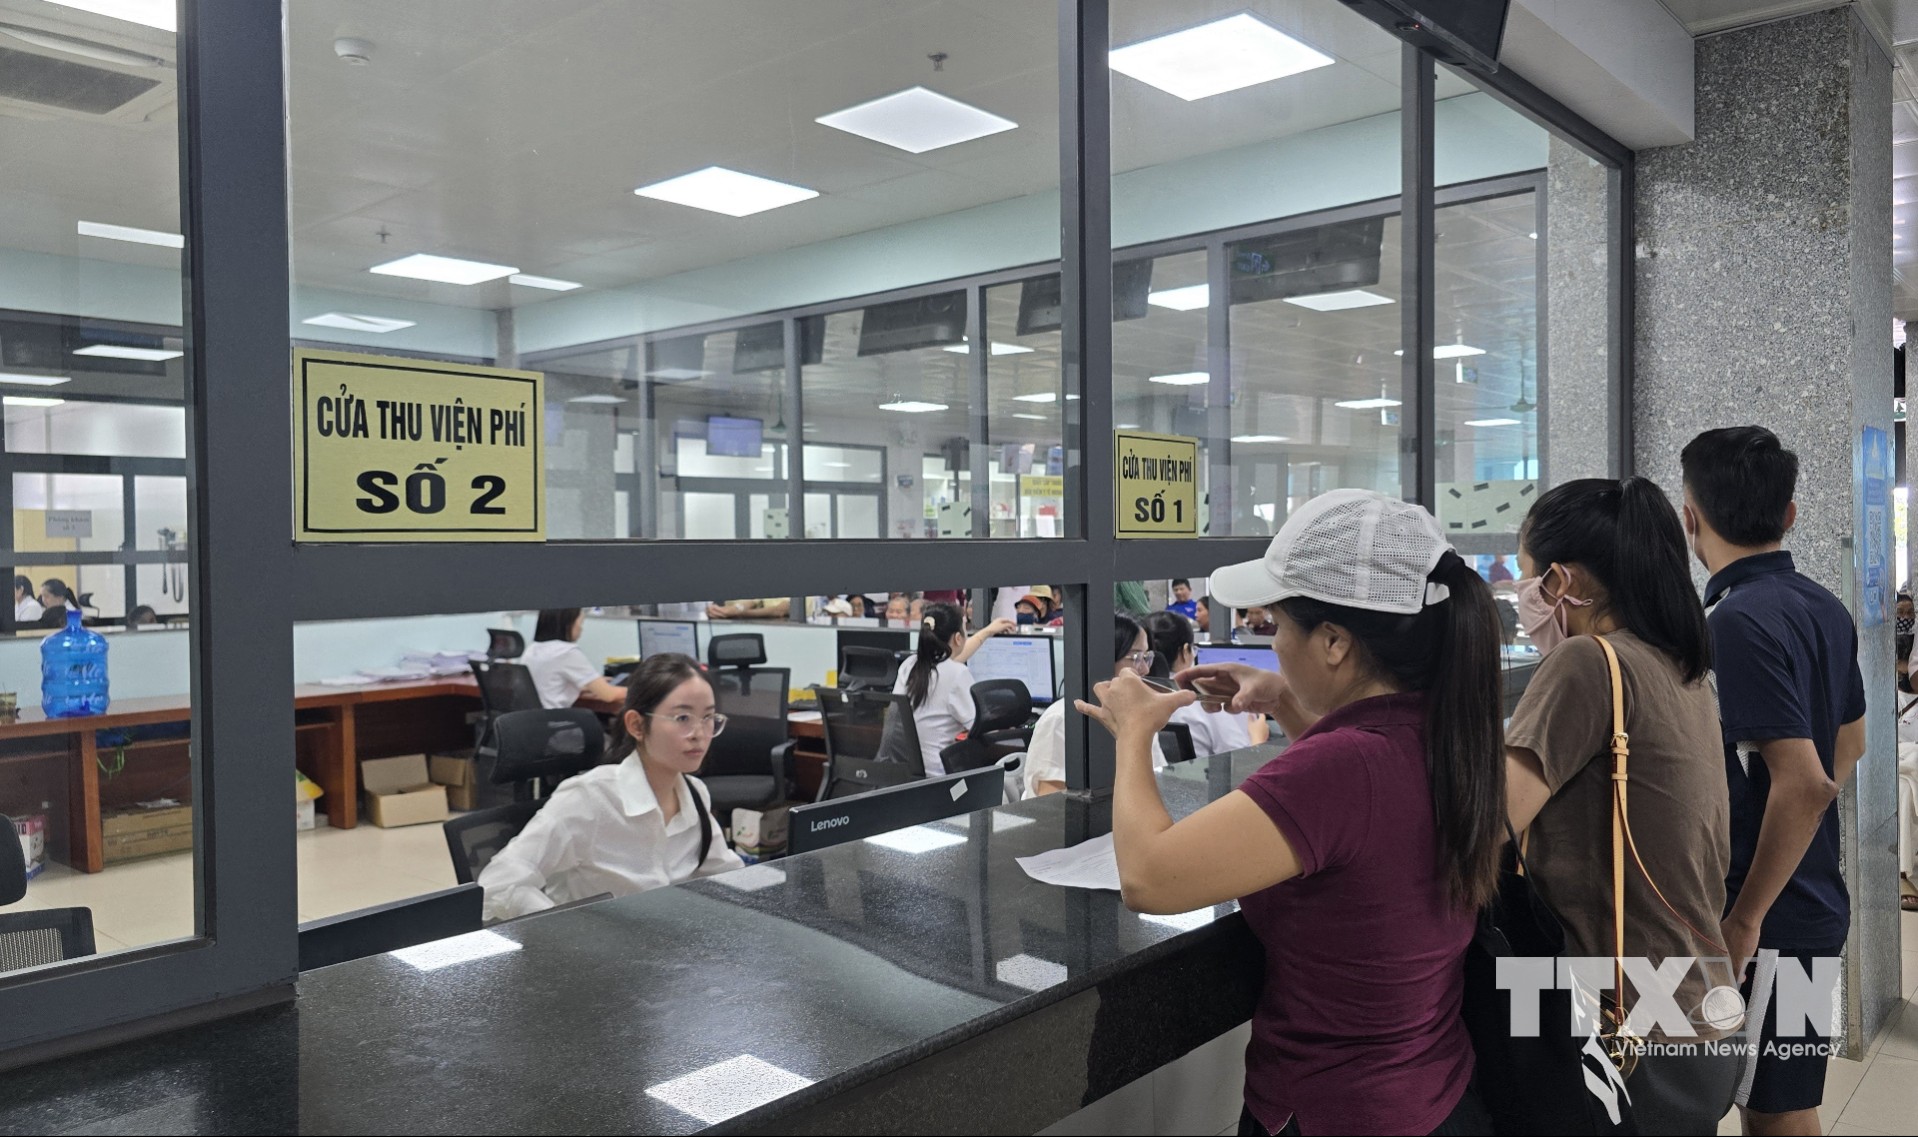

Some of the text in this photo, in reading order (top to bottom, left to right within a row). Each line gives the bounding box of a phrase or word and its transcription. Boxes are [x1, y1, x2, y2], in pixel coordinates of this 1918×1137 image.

[317, 383, 526, 450] CỬA THU VIỆN PHÍ
[356, 457, 506, 515] SỐ 2
[1122, 448, 1192, 486] CỬA THU VIỆN PHÍ
[1134, 489, 1182, 523] SỐ 1
[810, 815, 850, 832] Lenovo
